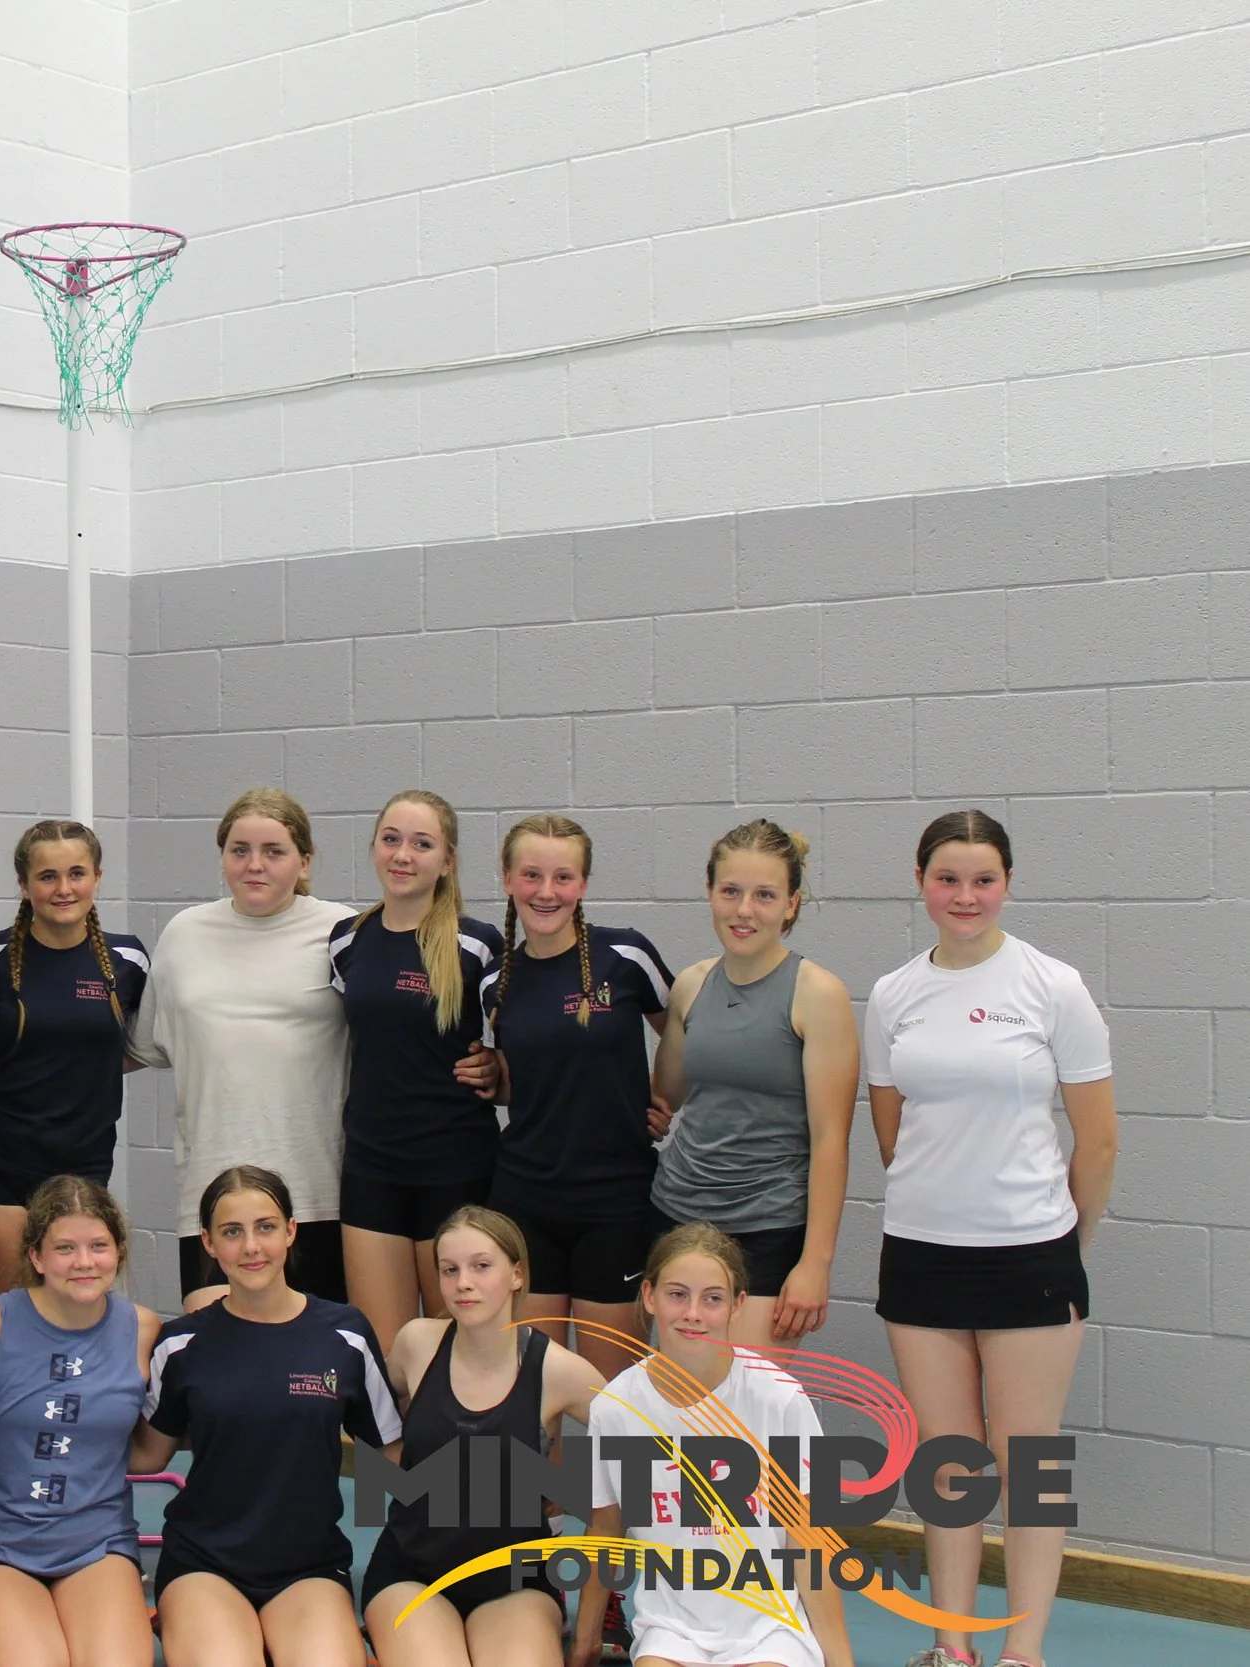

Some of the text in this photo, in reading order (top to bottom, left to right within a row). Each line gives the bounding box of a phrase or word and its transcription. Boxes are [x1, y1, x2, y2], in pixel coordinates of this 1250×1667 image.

[397, 979, 429, 990] NETBALL
[76, 989, 108, 997] NETBALL
[564, 1001, 600, 1010] NETLL
[987, 1014, 1026, 1026] squash
[289, 1383, 327, 1392] NETBALL
